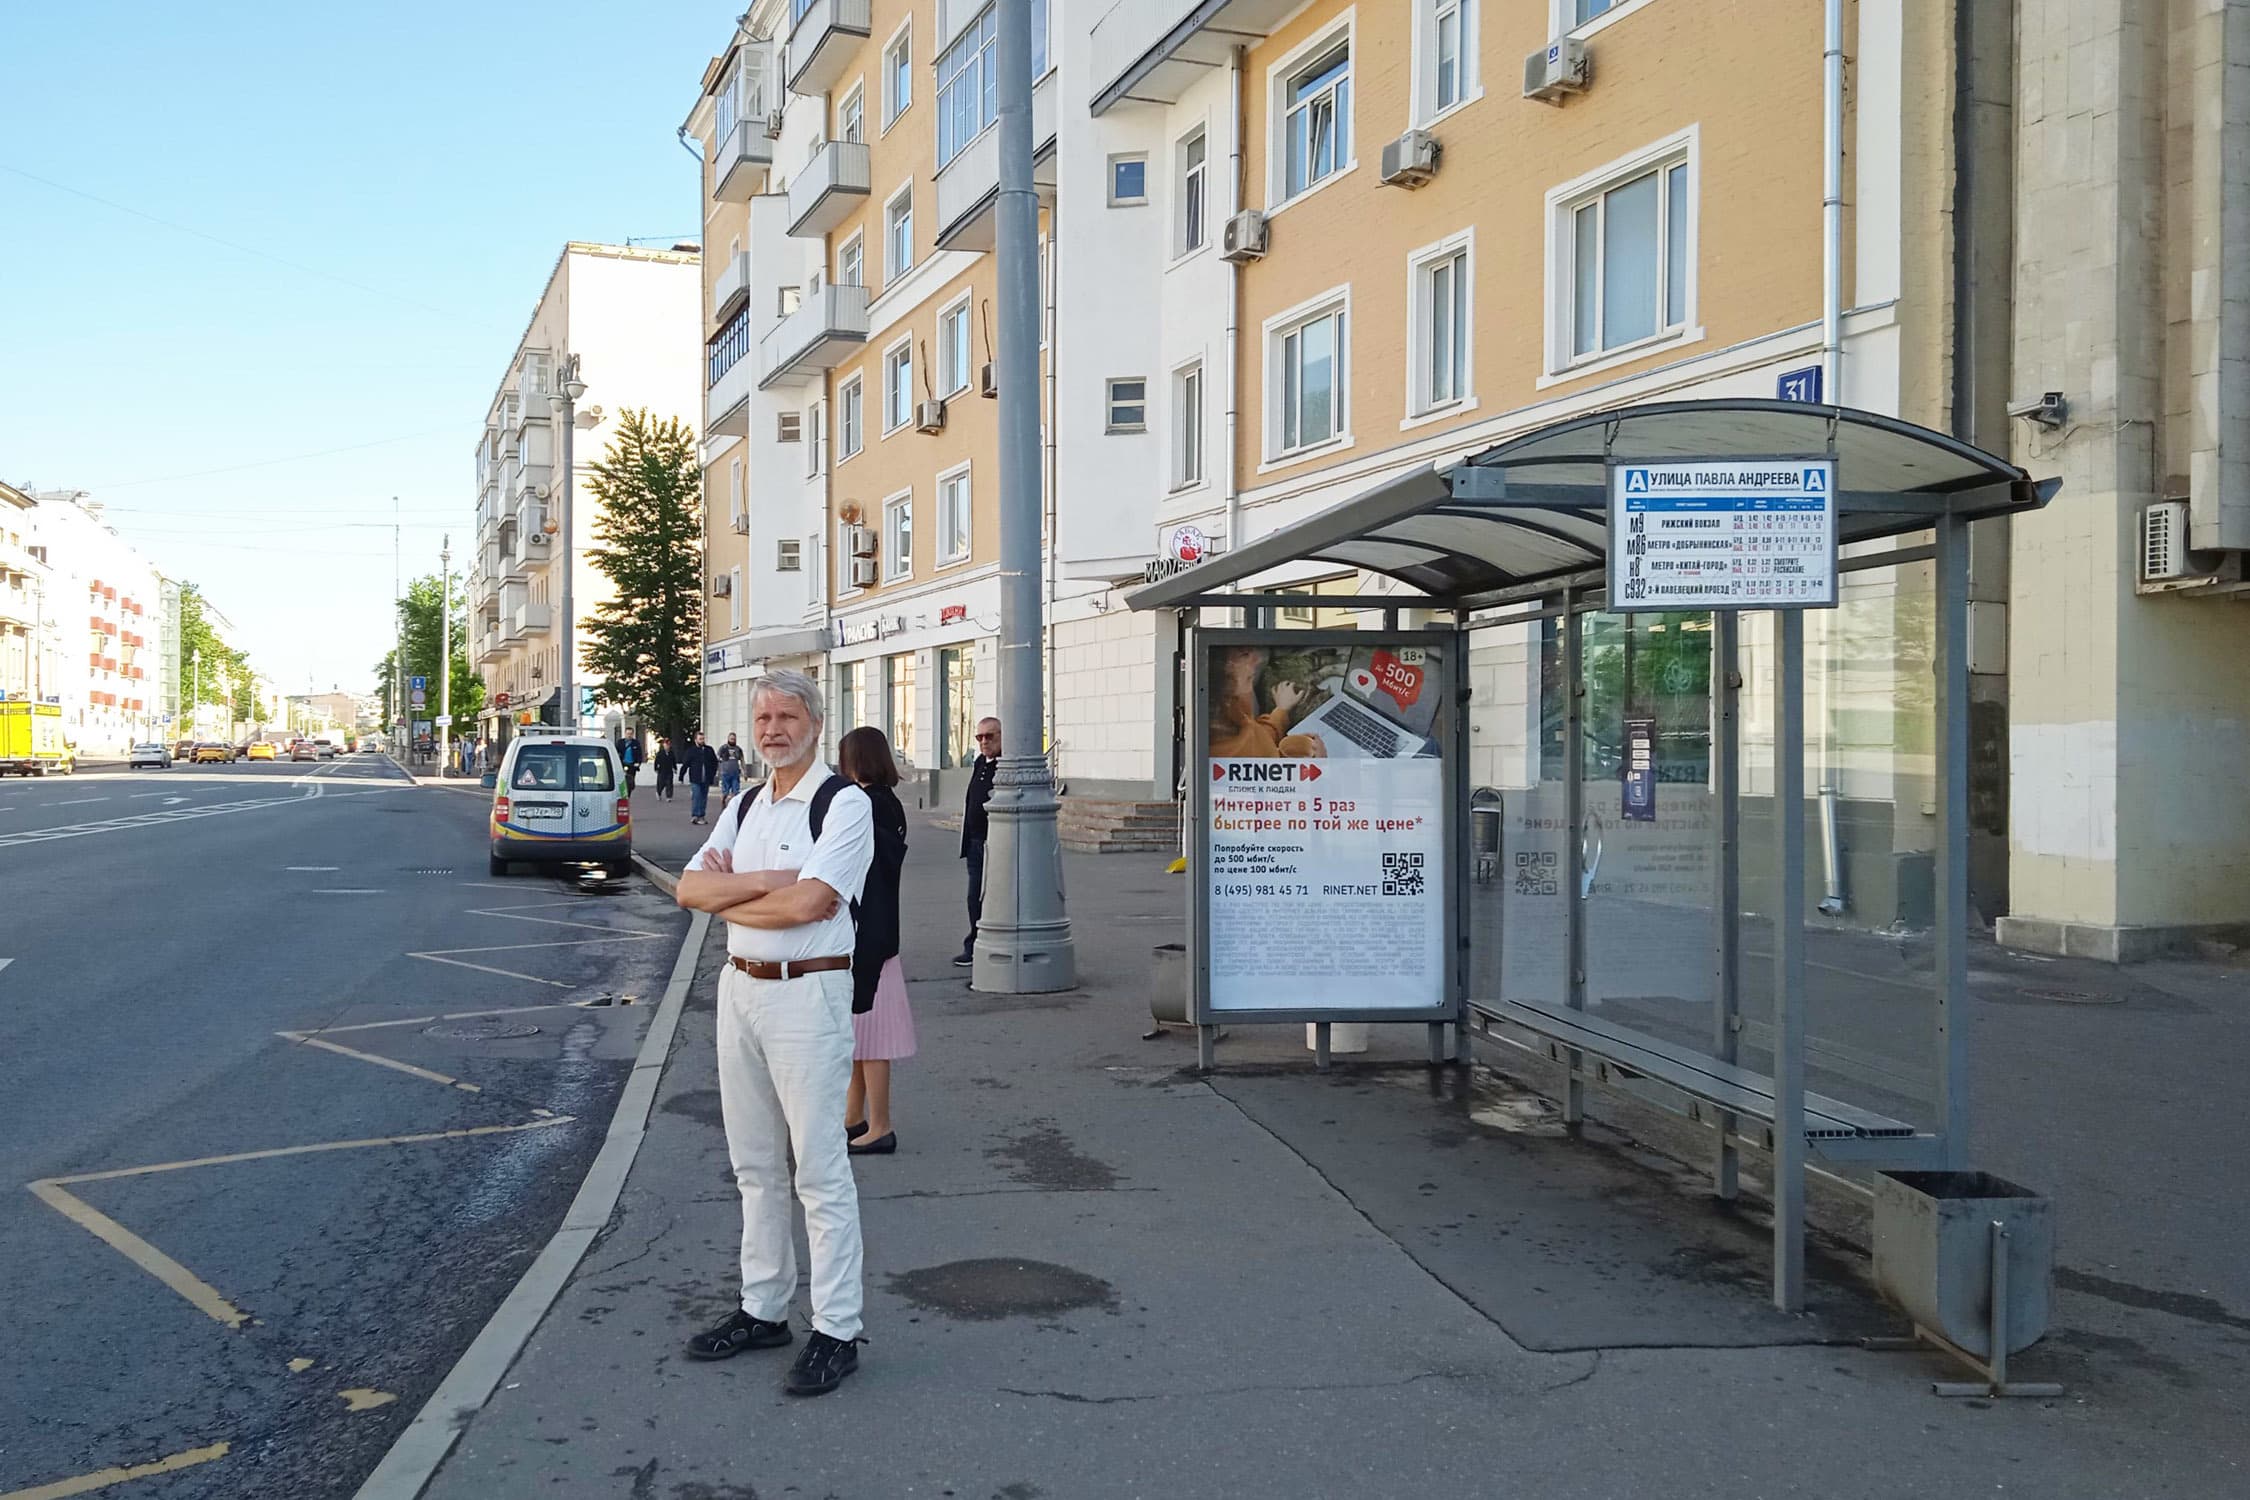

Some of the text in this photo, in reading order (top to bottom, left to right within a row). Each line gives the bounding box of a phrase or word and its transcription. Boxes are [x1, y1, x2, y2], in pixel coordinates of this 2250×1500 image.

[1650, 472, 1692, 486] УЛИЦА
[1695, 472, 1734, 485] ПАВЛА
[1738, 472, 1800, 486] АНДРЕЕВА
[1662, 518, 1693, 528] РИЖСКИЙ
[1695, 520, 1720, 528] ВОКЗАЛ
[1648, 540, 1670, 549] МЕТРО
[1651, 561, 1674, 570] МЕТРО
[1676, 560, 1727, 571] «КИТАЙ-ГОРОД»
[1661, 584, 1702, 594] ПАВЕЛЕЦКИЙ
[1704, 586, 1730, 595] ПРОЕЗД
[1404, 651, 1423, 661] 18+
[1386, 663, 1415, 688] 500
[1214, 798, 1355, 814] Интернет в 5 раз
[1214, 816, 1281, 832] быстрее
[1288, 820, 1306, 830] по
[1313, 816, 1341, 830] той
[1348, 820, 1368, 830] же
[1214, 844, 1304, 853] Попробуйте скорость
[1229, 855, 1244, 863] 500
[1247, 854, 1275, 864] мбит/с
[1227, 866, 1248, 874] цене
[1250, 865, 1266, 873] 100
[1269, 865, 1297, 874] мбит/с
[1214, 884, 1378, 896] 8 (495) 981 45 71 RINET.NET
